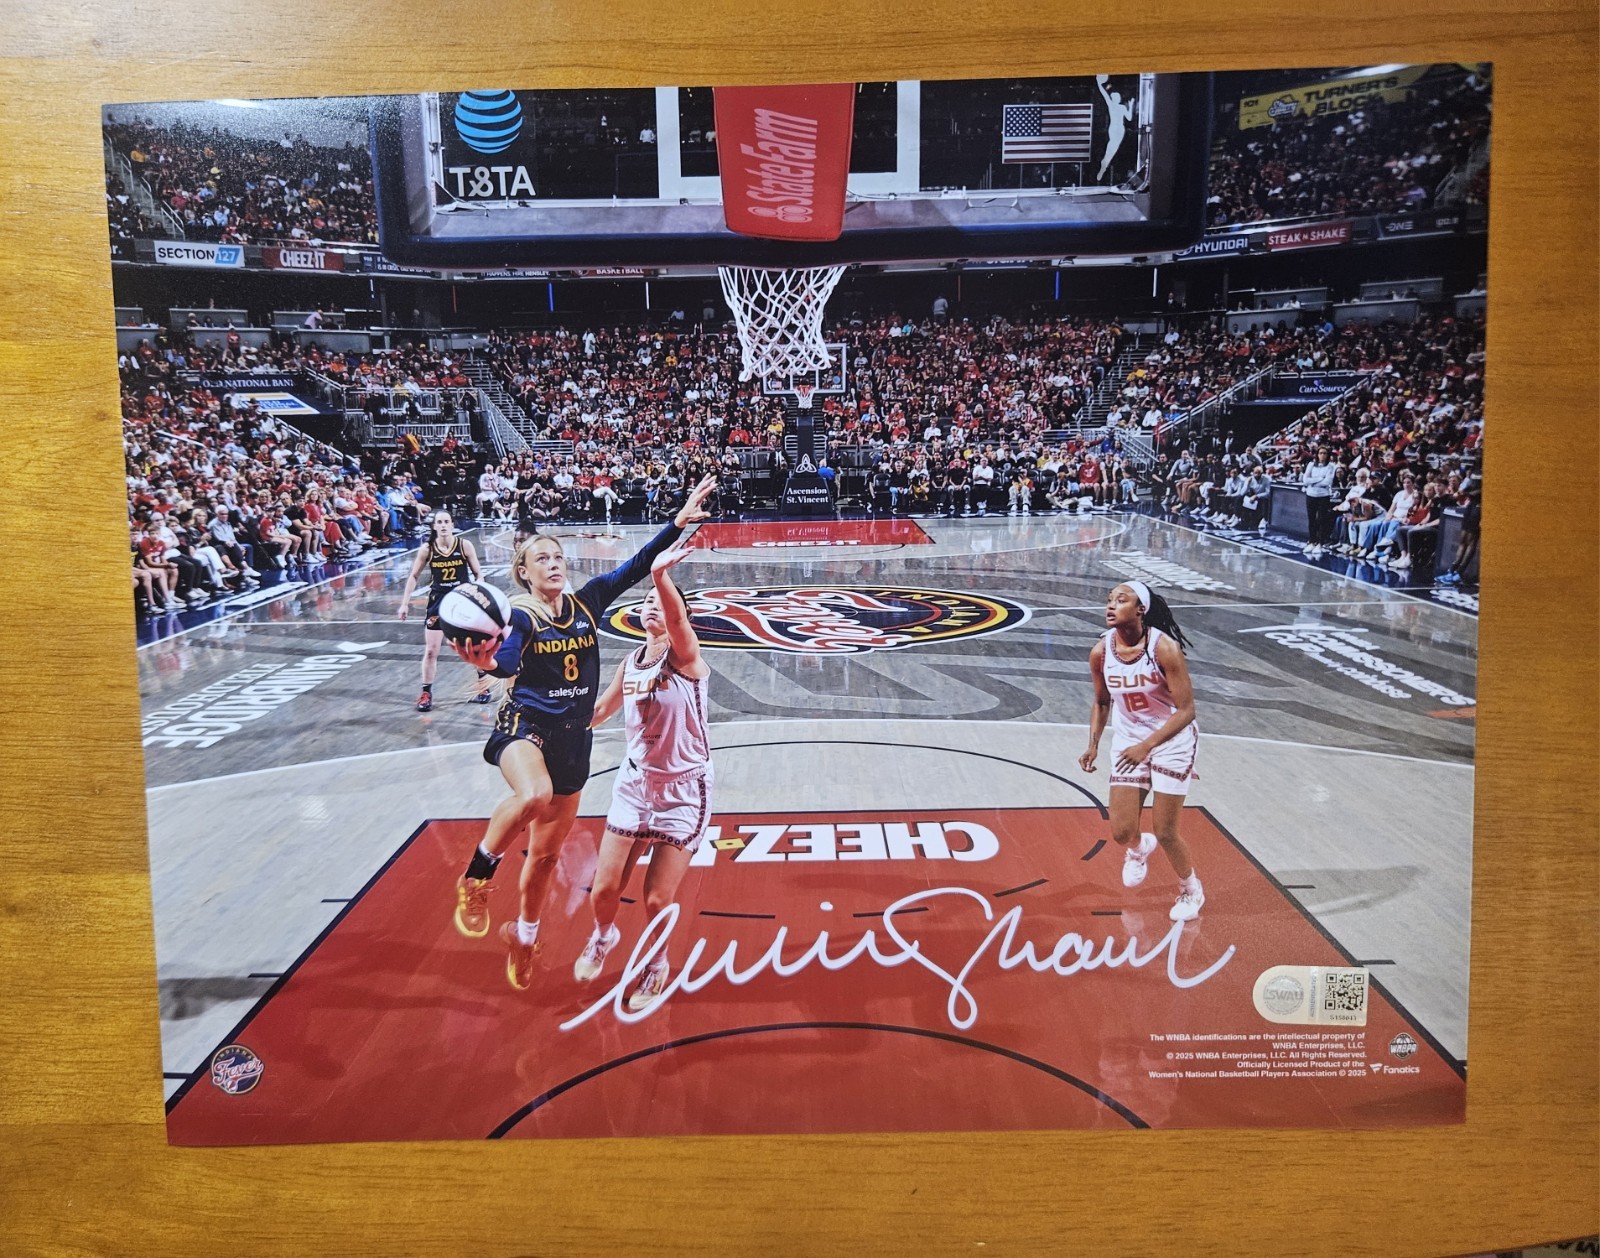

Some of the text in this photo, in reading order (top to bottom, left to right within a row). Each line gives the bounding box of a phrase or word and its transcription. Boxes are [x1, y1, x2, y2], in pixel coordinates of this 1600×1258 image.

[1268, 233, 1301, 246] STEAK
[1310, 228, 1347, 241] SHAKE
[1194, 238, 1248, 254] HYUNDAI
[158, 247, 215, 260] SECTION
[225, 379, 271, 389] NATIONAL
[1299, 384, 1347, 394] CareSource
[786, 487, 827, 495] Ascension
[786, 496, 798, 504] St.
[431, 559, 464, 568] INDIANA
[441, 568, 457, 581] 22
[533, 634, 595, 654] INDIANA
[563, 653, 579, 682] 8
[1107, 672, 1160, 689] SUN
[142, 654, 368, 748] GAINBRIDGE
[1121, 691, 1150, 713] 18
[1149, 1033, 1165, 1041] The
[1165, 1033, 1191, 1041] WNBA
[1192, 1033, 1247, 1041] identifications
[1321, 1033, 1355, 1041] property
[1299, 1041, 1346, 1050] Enterprises,
[1348, 1041, 1365, 1049] LLC.
[1222, 1052, 1269, 1060] Enterprises,
[1270, 1051, 1288, 1059] LLC.
[1301, 1051, 1327, 1060] Rights
[1237, 1061, 1271, 1069] Officially
[1383, 1065, 1420, 1074] Fanatics
[213, 1057, 264, 1084] Fever
[1261, 1070, 1289, 1079] Players
[1347, 1069, 1367, 1077] 2025
